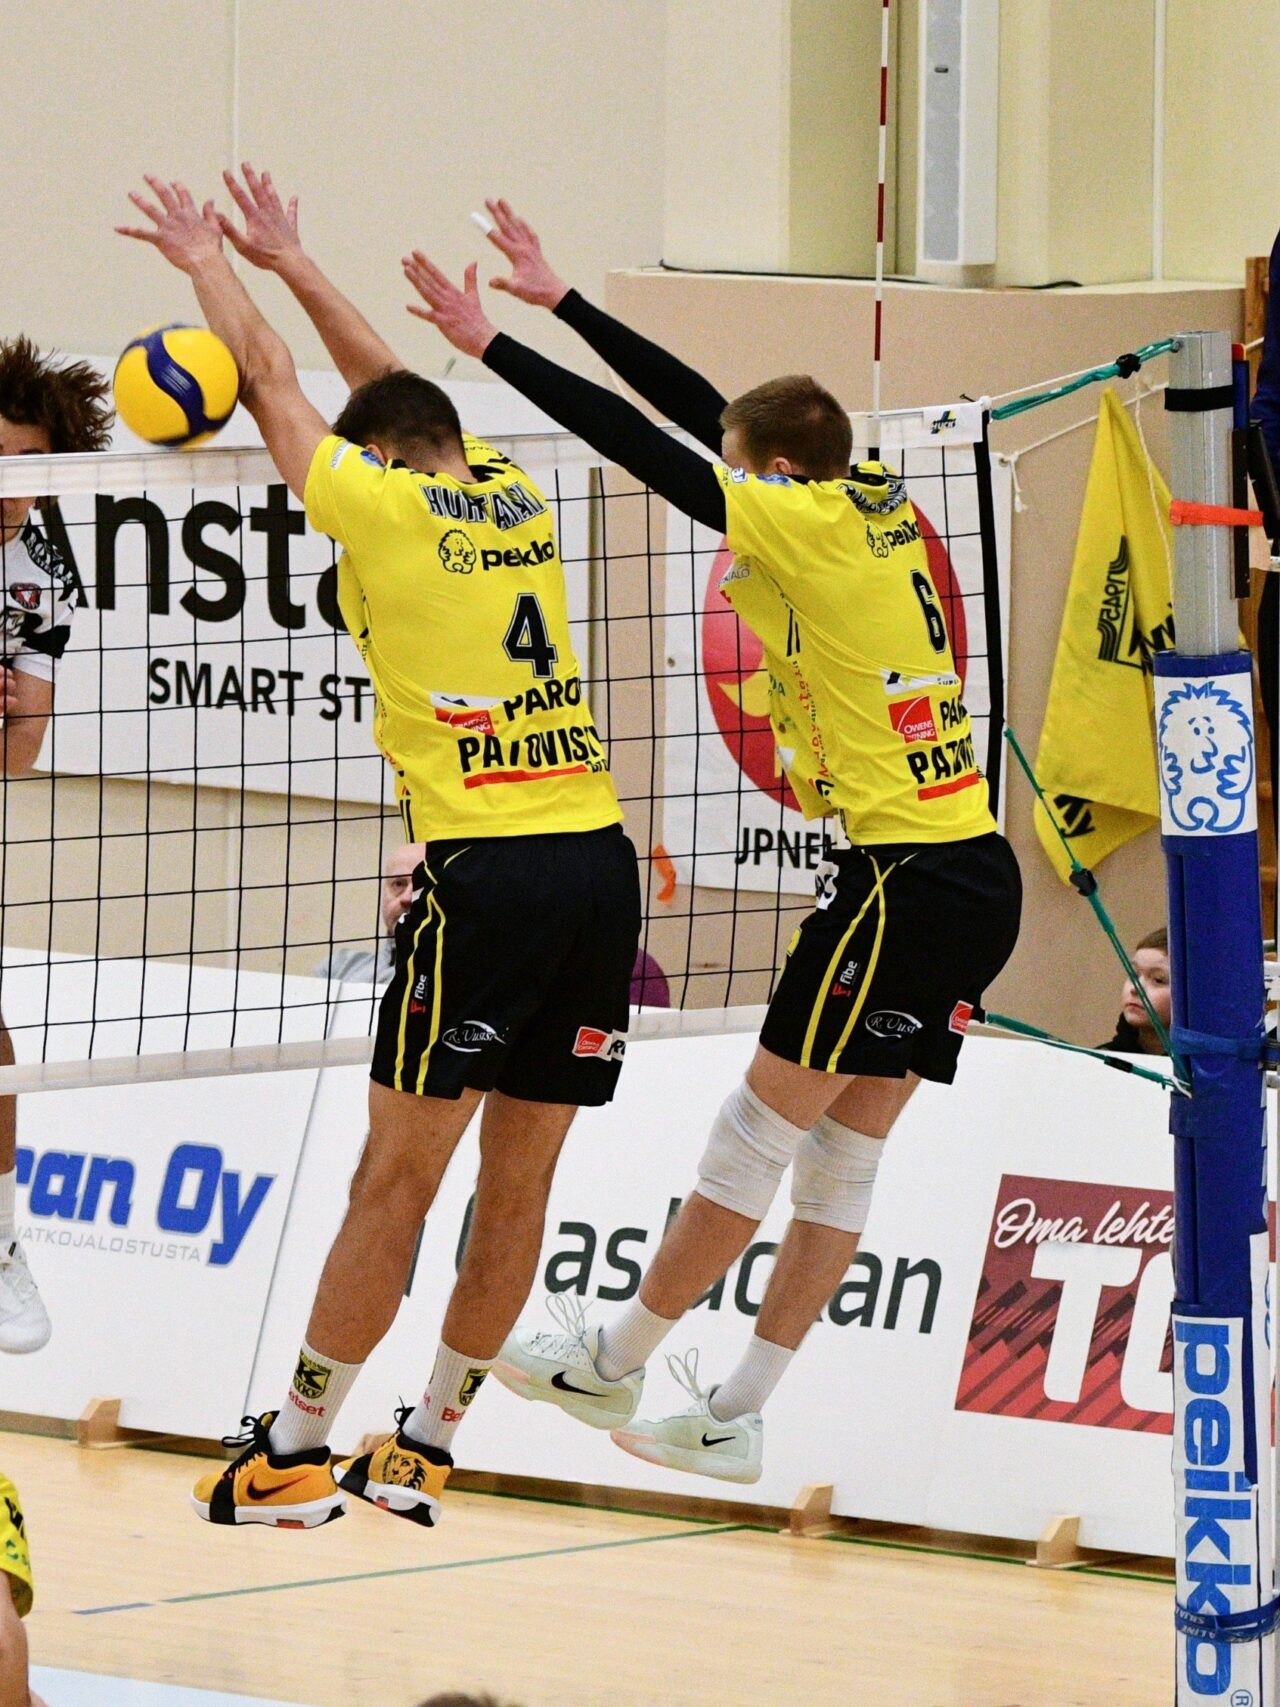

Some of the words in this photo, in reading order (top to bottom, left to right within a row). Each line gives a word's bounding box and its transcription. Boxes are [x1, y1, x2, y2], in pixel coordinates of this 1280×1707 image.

[502, 592, 558, 679] 4
[910, 569, 947, 654] 6
[148, 656, 304, 717] SMART
[155, 1141, 277, 1269] Oy
[993, 1198, 1088, 1248] Oma
[1175, 1322, 1252, 1696] peikko
